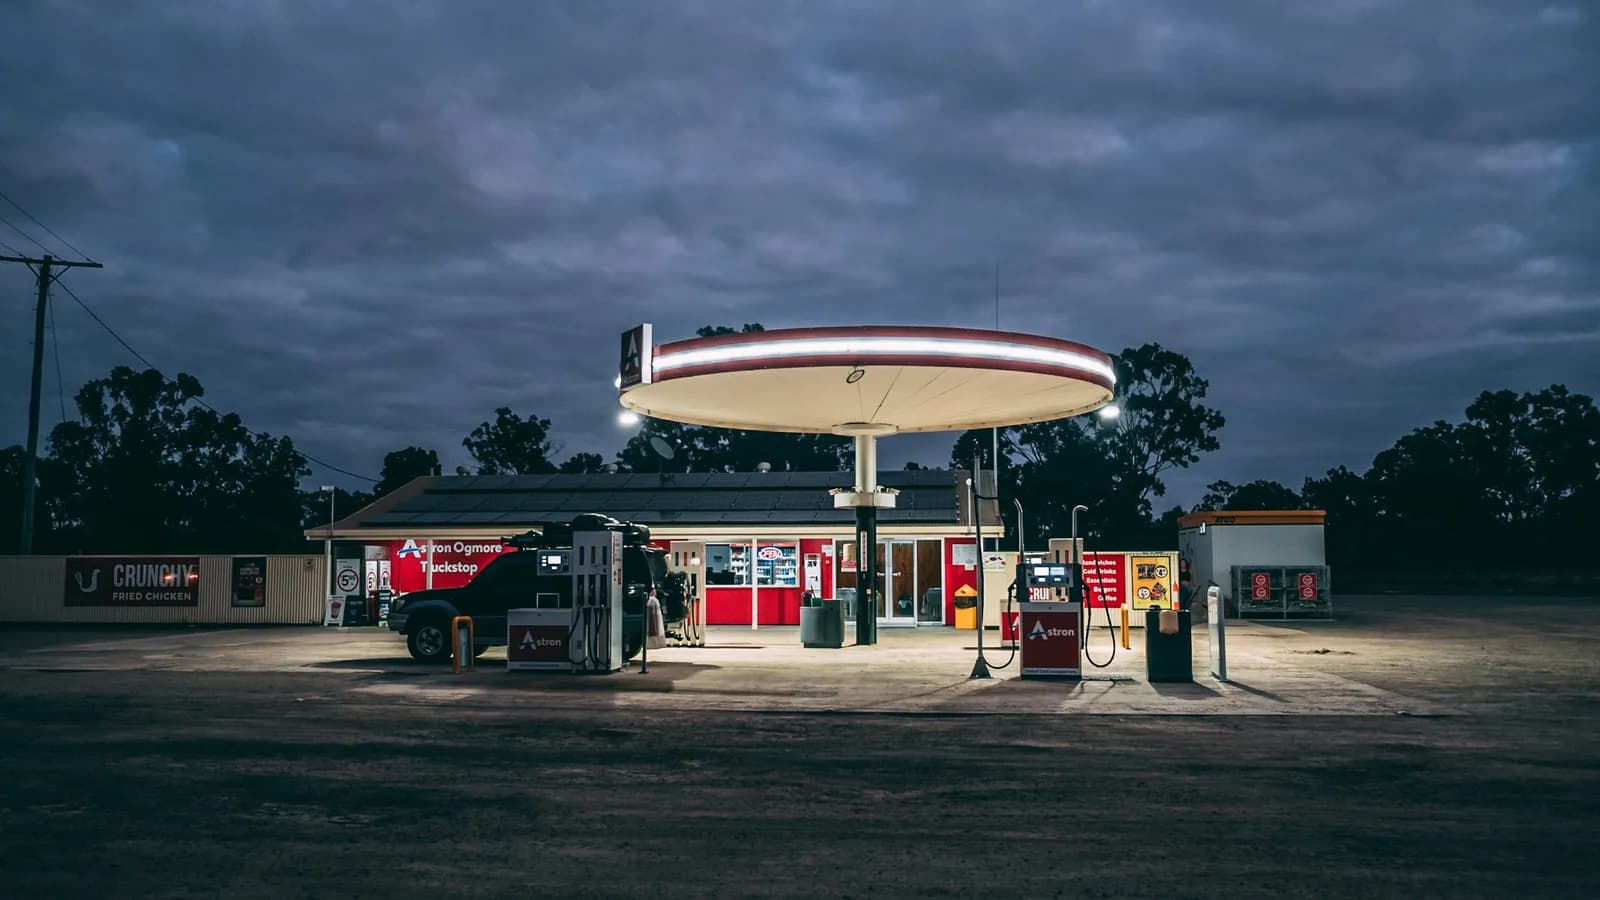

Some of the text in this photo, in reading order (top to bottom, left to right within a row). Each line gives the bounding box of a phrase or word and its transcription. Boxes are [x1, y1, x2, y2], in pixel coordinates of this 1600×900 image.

[397, 539, 503, 558] Asron Ogmore
[113, 564, 193, 587] CRUNCHY
[420, 561, 478, 576] Tuckstop
[112, 592, 191, 600] FRIED CHICKEN
[1093, 586, 1117, 594] Bugers
[1027, 620, 1075, 640] Astron
[520, 631, 562, 650] Astron
